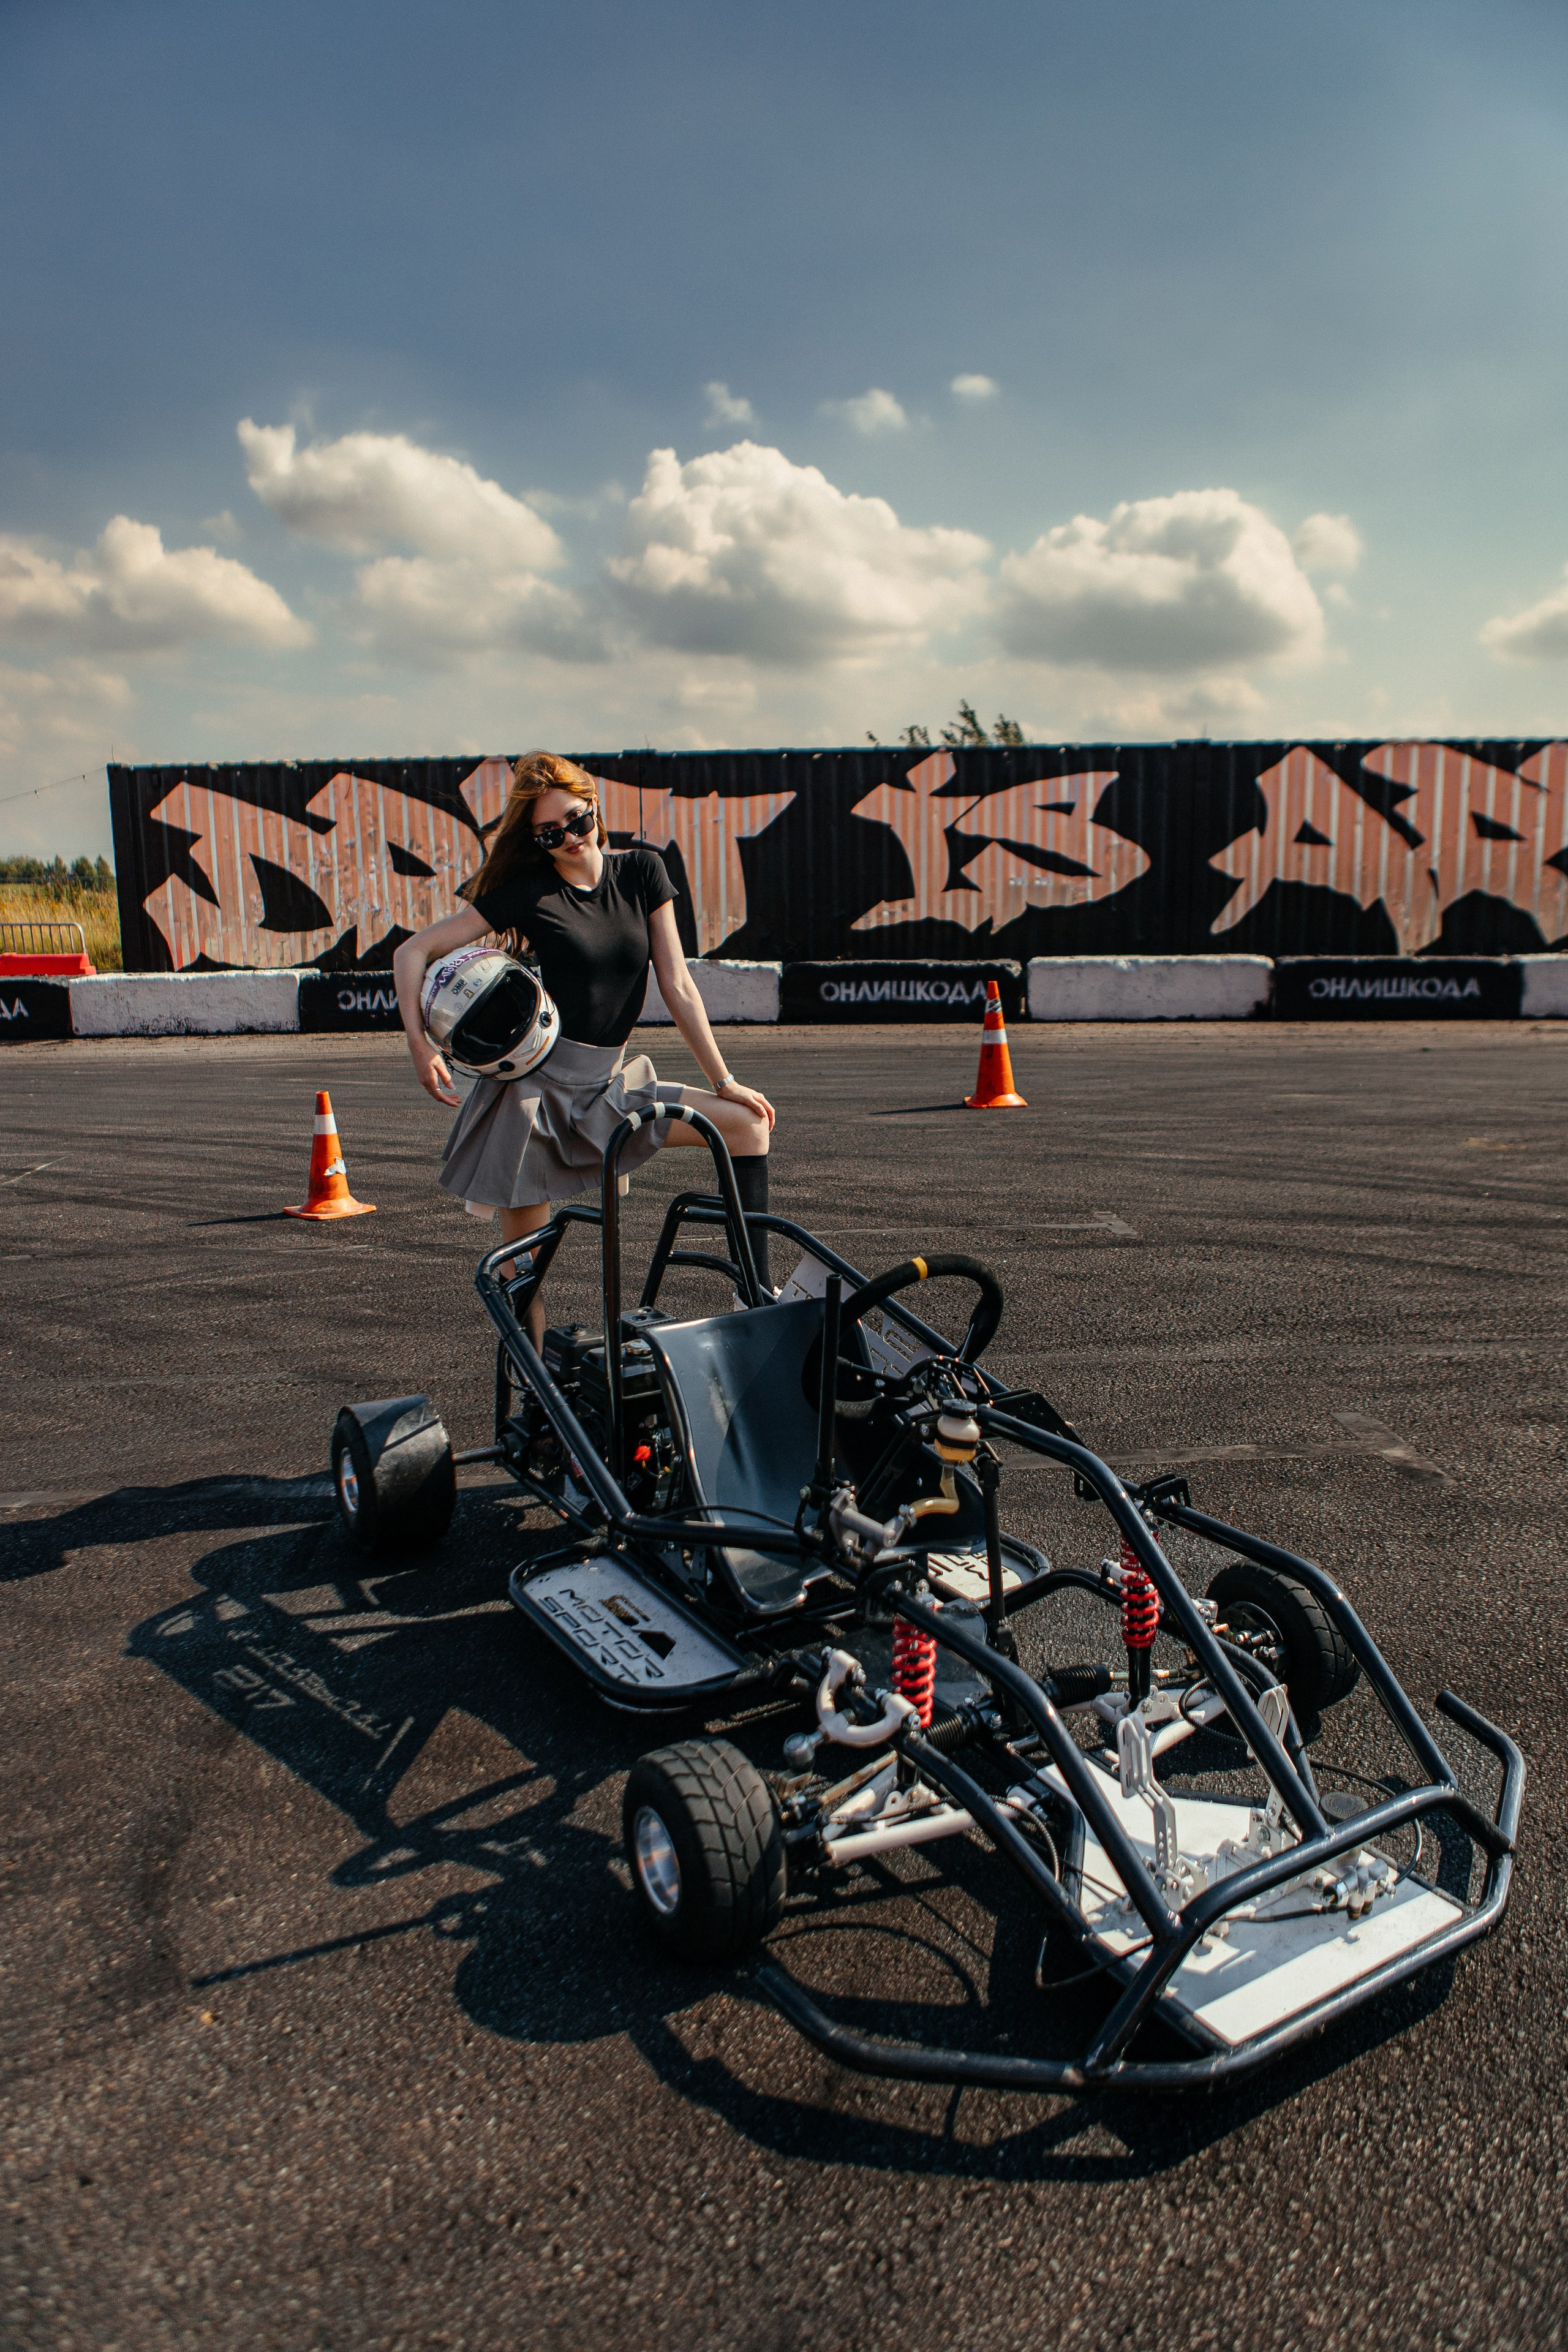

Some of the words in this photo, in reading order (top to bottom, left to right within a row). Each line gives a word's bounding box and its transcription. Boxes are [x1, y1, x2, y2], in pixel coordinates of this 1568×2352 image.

[1208, 742, 1568, 956] AR
[453, 979, 467, 996] OMP
[820, 980, 988, 1004] ОНЛИШКОДА
[1308, 976, 1481, 1000] ОНЛИШКОДА
